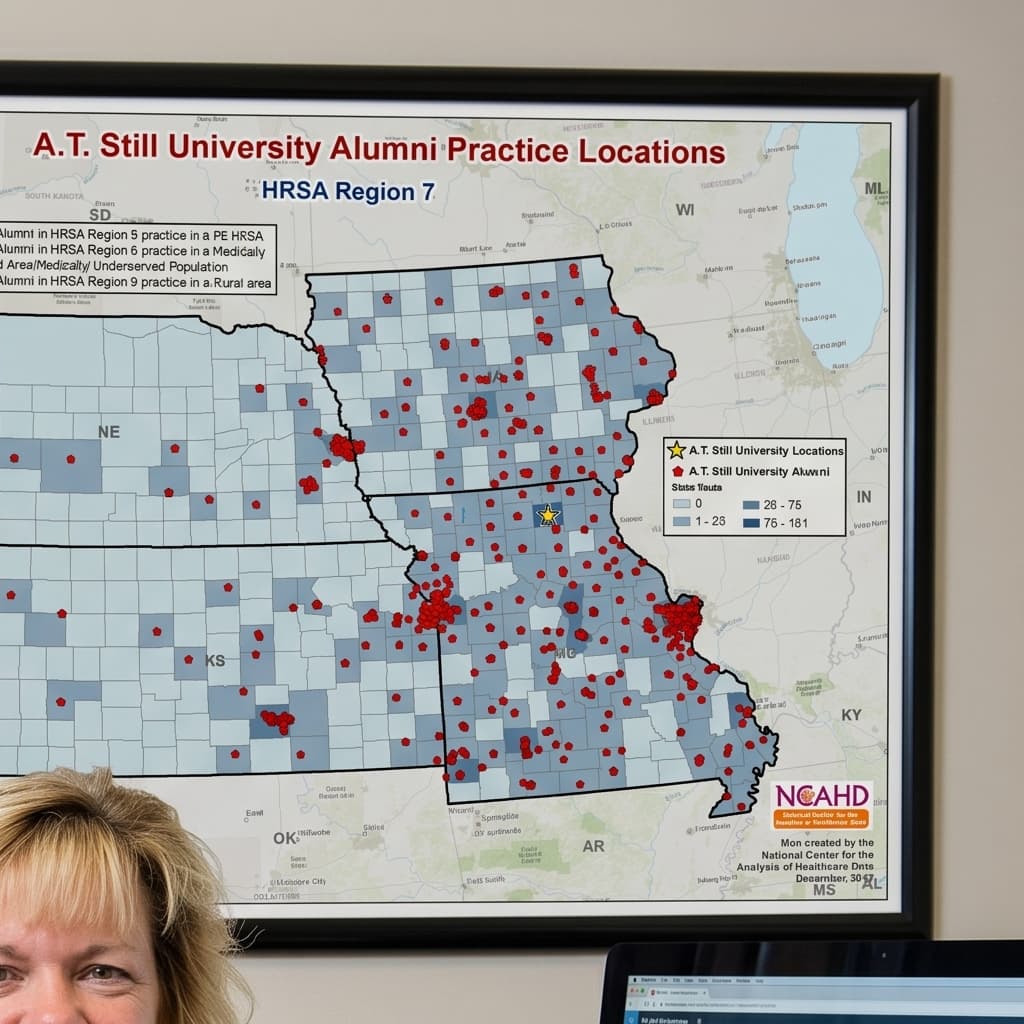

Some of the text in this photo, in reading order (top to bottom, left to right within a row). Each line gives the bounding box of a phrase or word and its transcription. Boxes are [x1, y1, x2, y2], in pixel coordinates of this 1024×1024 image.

[33, 132, 726, 166] A.T. Still University Alumni Practice Locations
[262, 180, 435, 205] HRSA Region 7
[89, 208, 111, 222] SD
[676, 203, 694, 216] WI
[38, 229, 47, 239] in
[50, 228, 85, 239] HRSA
[88, 229, 127, 242] Region
[131, 230, 138, 240] 5
[141, 230, 186, 244] practice
[190, 230, 199, 240] in
[203, 232, 209, 241] a
[213, 230, 227, 241] PE
[231, 231, 264, 241] HRSA
[38, 244, 47, 254] in
[50, 244, 85, 255] HRSA
[88, 244, 127, 258] Region
[131, 245, 138, 256] 6
[141, 245, 187, 258] practice
[190, 245, 200, 256] in
[203, 248, 209, 256] a
[93, 260, 166, 271] Underserved
[169, 261, 229, 274] Population
[38, 275, 47, 286] in
[50, 276, 85, 286] HRSA
[88, 276, 127, 289] Region
[131, 277, 138, 287] 9
[141, 277, 186, 289] practice
[190, 277, 199, 287] in
[214, 278, 244, 288] Rural
[247, 280, 272, 289] area
[98, 425, 121, 439] NE
[689, 446, 844, 457] A.T. Still University Locations
[689, 467, 709, 476] A.T.
[712, 467, 733, 476] Still
[736, 467, 789, 478] University
[857, 490, 872, 503] IN
[205, 655, 225, 667] KS
[842, 709, 862, 721] KY
[776, 784, 869, 807] NCAHD
[273, 832, 297, 845] OK
[804, 838, 841, 847] created
[844, 838, 856, 849] by
[858, 838, 874, 847] the
[583, 840, 605, 853] AR
[761, 850, 874, 860] National Center for the
[736, 862, 780, 873] Analysis
[783, 862, 793, 871] of
[813, 884, 836, 896] MS
